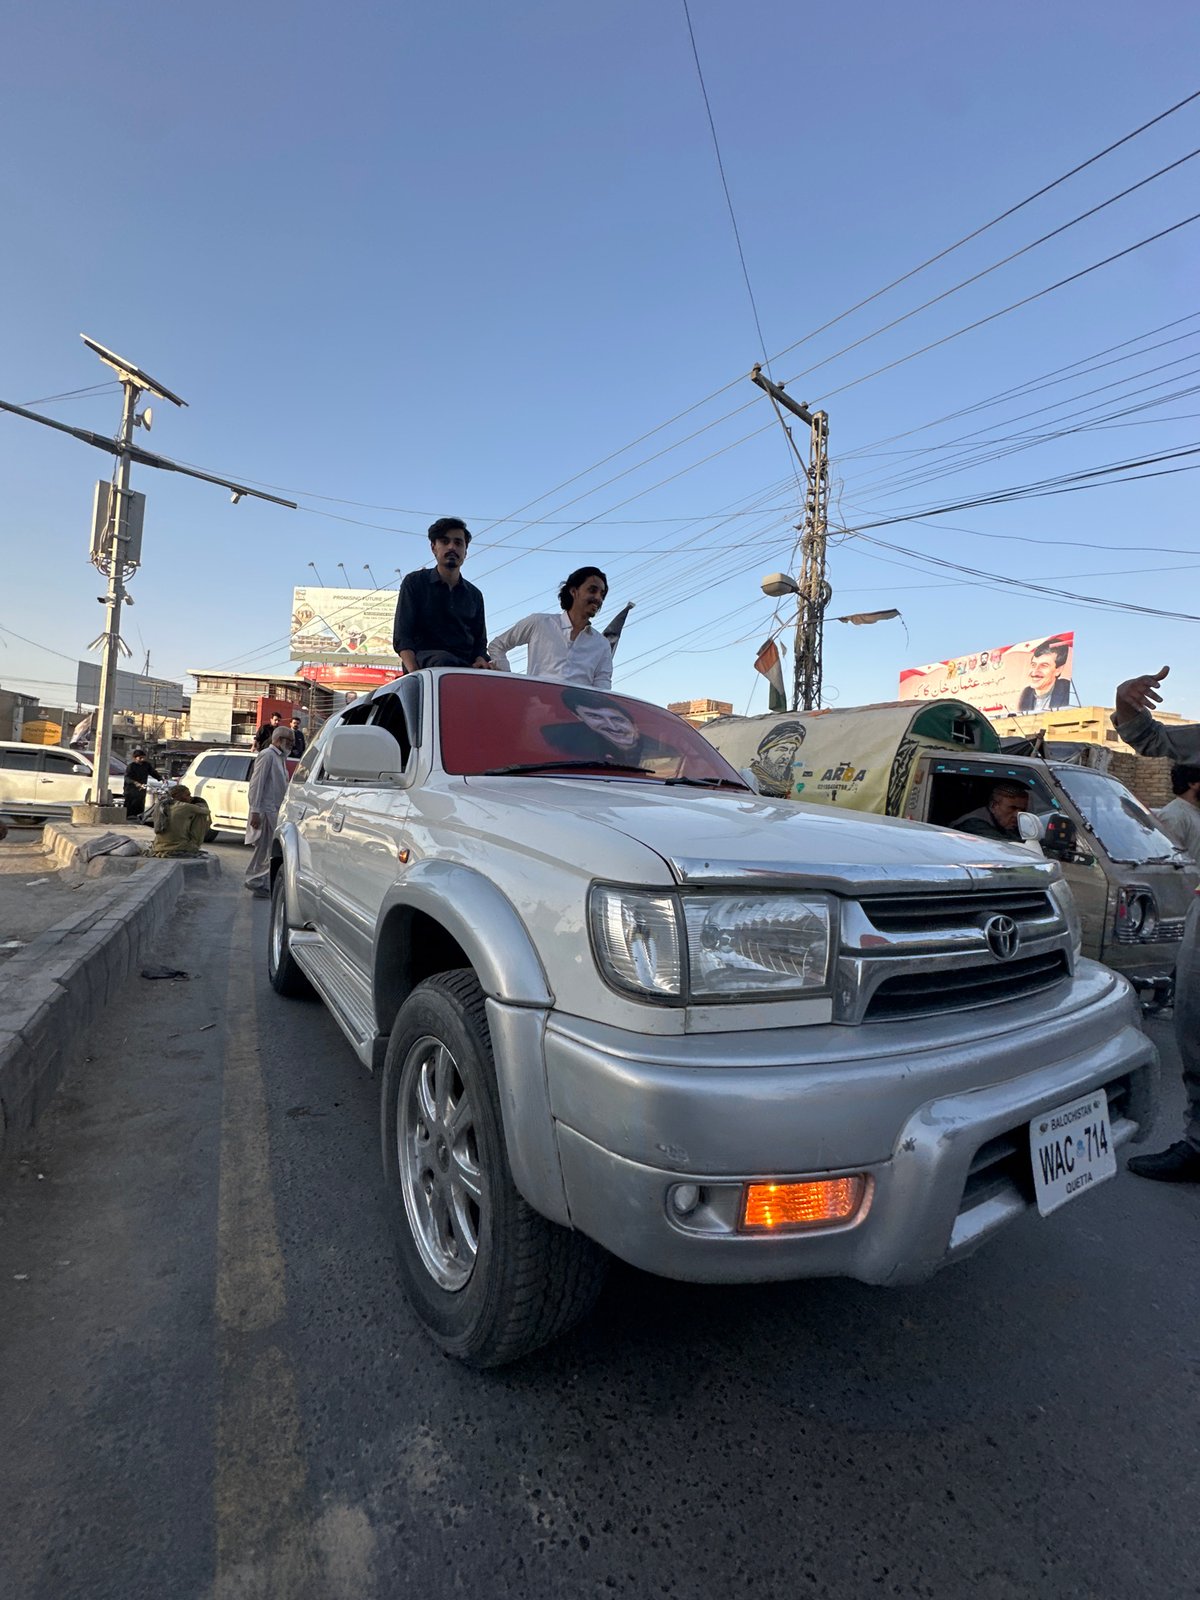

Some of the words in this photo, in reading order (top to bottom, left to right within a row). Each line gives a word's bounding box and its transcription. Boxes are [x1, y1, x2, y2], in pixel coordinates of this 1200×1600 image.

[931, 680, 949, 697] خان
[951, 676, 980, 694] عثمان
[1050, 1105, 1092, 1130] BALOCHISTAN
[1039, 1135, 1075, 1185] WAC
[1084, 1120, 1108, 1162] 714
[1066, 1172, 1093, 1194] QUETTA
